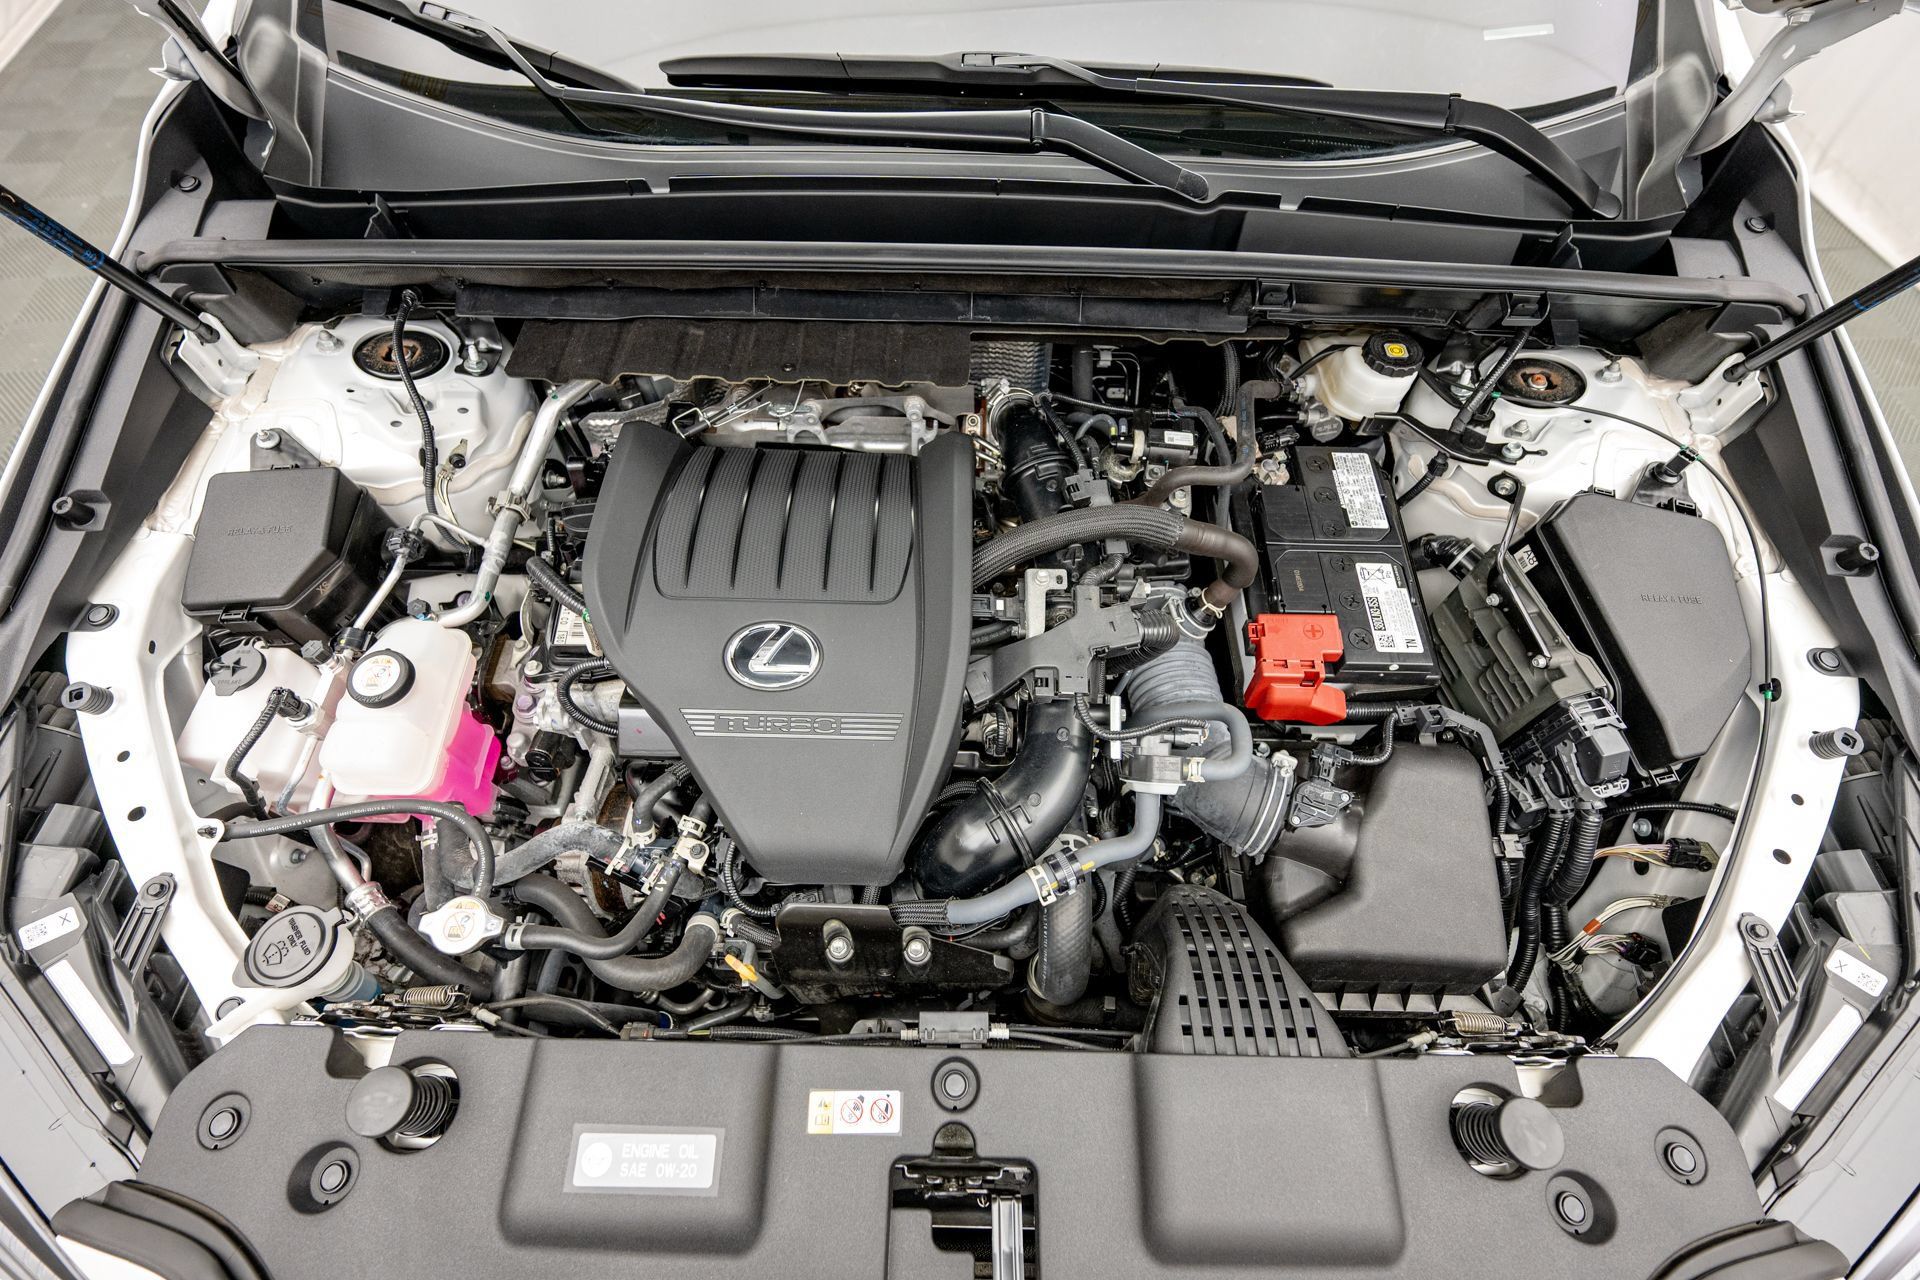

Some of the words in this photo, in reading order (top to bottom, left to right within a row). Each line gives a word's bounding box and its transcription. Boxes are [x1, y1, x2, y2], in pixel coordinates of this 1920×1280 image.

[1640, 593, 1668, 602] RELAY
[1678, 596, 1702, 605] FUSE
[719, 715, 836, 734] TURBO
[287, 935, 298, 948] ONLY
[288, 917, 303, 940] WASHER
[299, 940, 311, 956] FLUID
[621, 1143, 671, 1159] ENGINE
[678, 1144, 699, 1160] OIL
[619, 1162, 647, 1178] SAE
[655, 1163, 698, 1178] 0W-20
